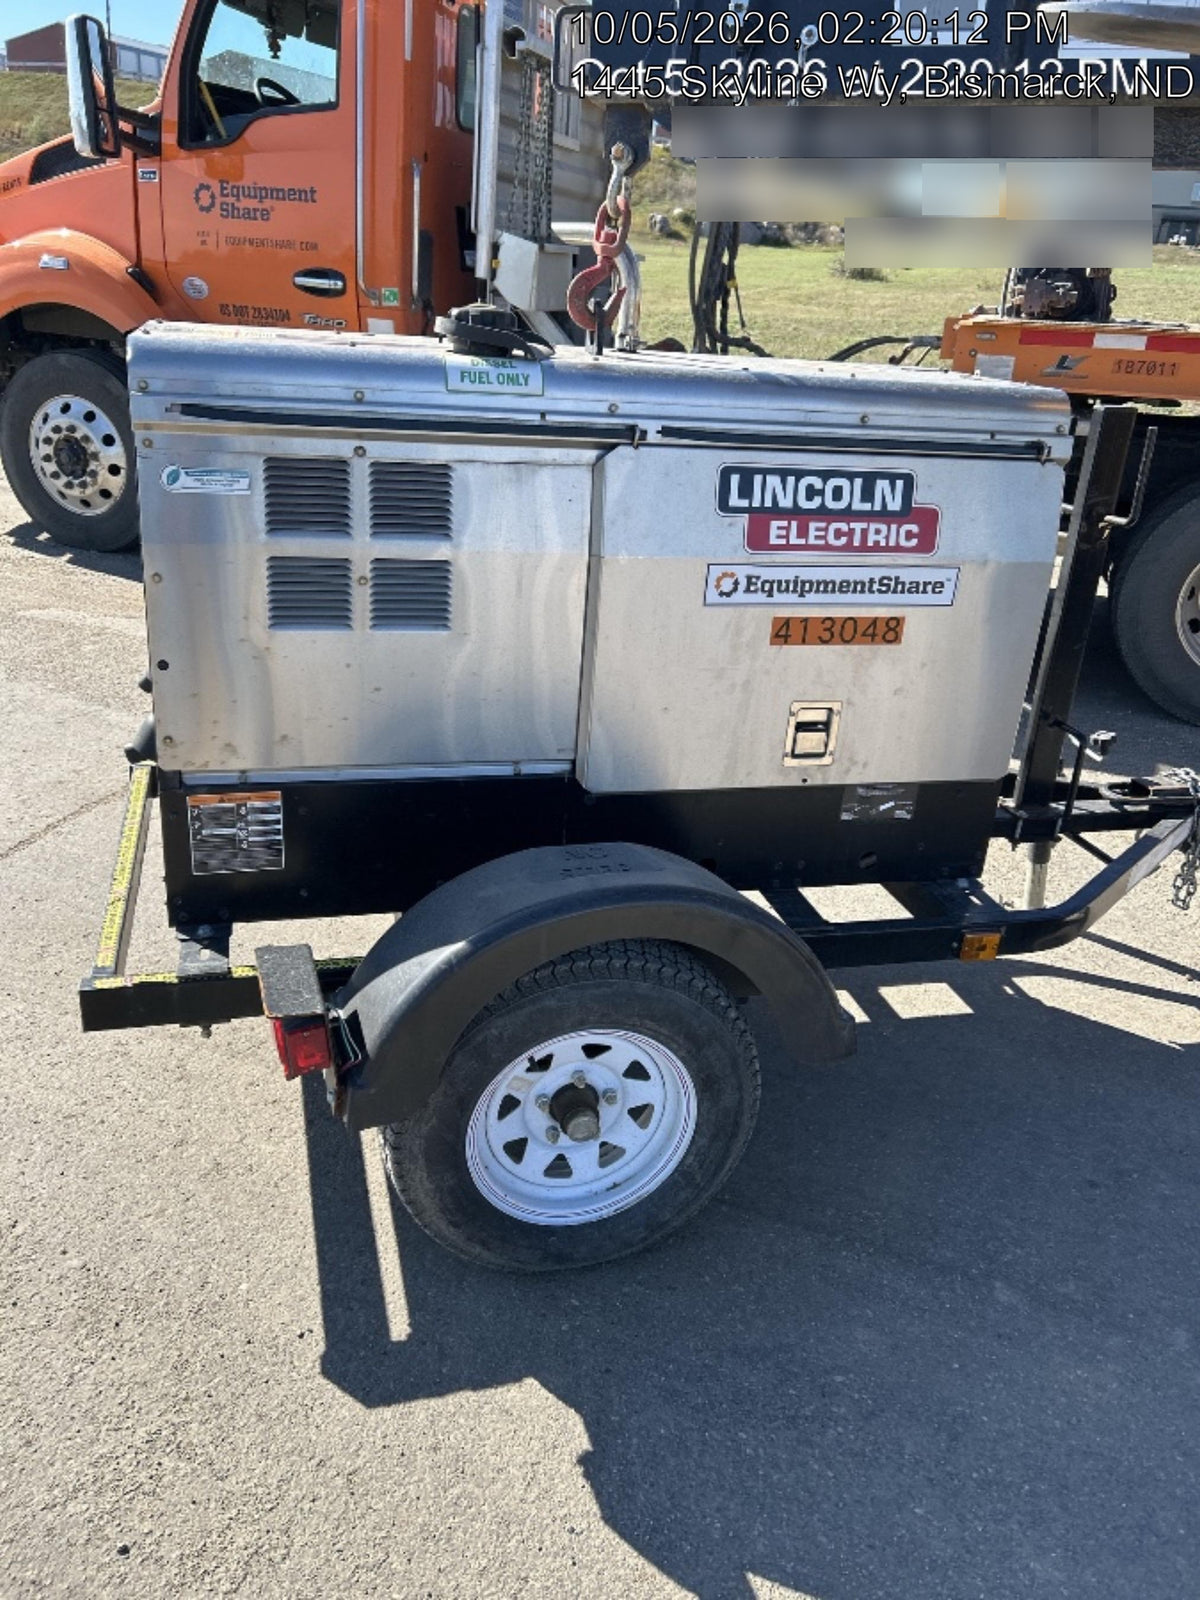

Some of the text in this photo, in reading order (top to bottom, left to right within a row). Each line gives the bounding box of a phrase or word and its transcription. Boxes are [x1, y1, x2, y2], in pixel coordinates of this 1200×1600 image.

[219, 179, 317, 203] Equipment
[220, 202, 270, 221] Share
[460, 371, 530, 386] FUEL ONLY
[728, 473, 904, 511] LINCOLN
[769, 520, 919, 547] ELECTRIC
[774, 616, 901, 644] 413048
